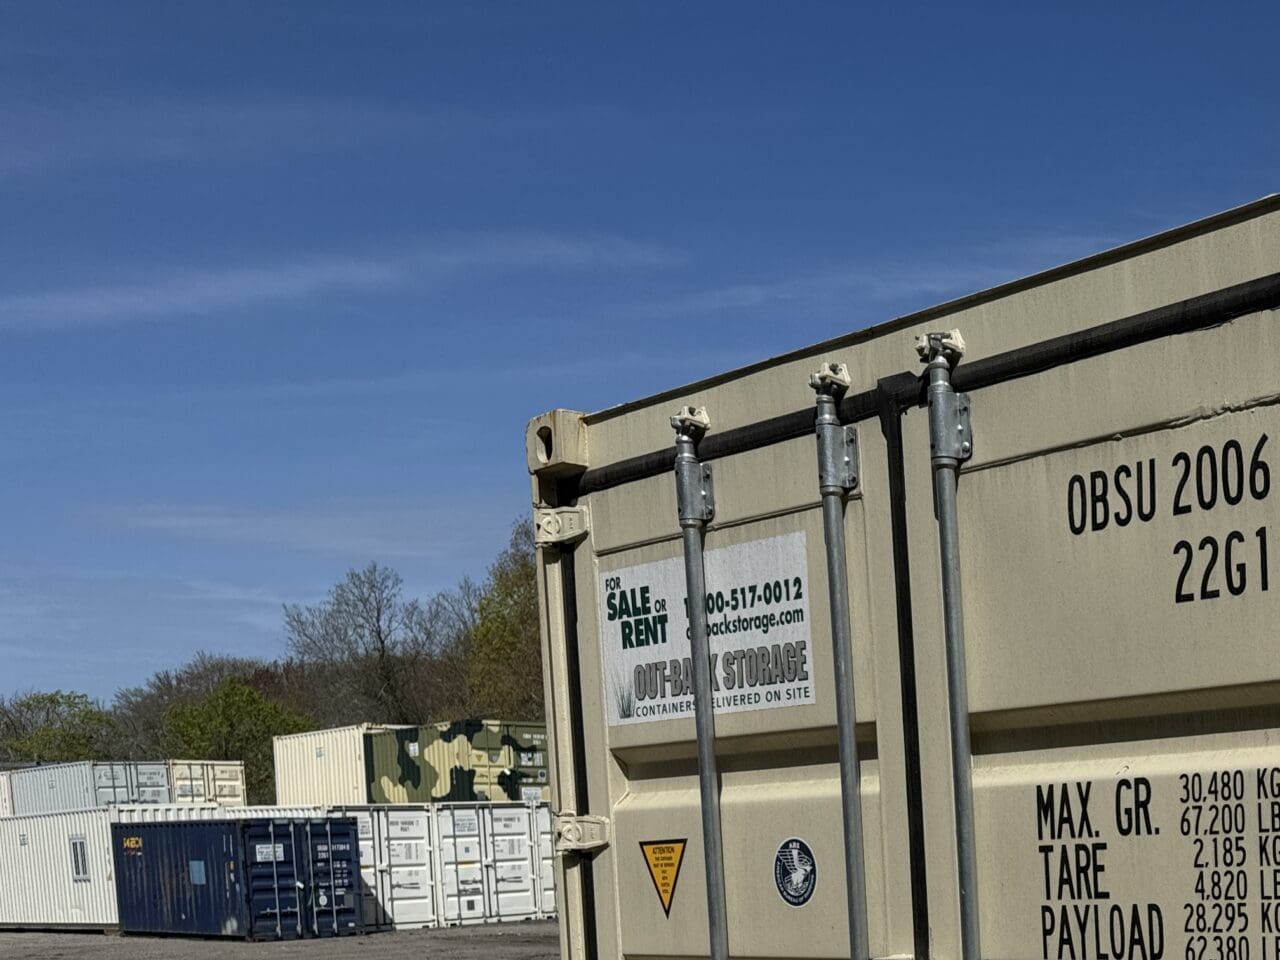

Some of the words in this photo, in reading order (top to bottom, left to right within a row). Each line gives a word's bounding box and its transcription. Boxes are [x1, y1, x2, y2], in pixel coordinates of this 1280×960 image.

[1067, 458, 1156, 535] OBSU
[605, 576, 622, 592] FOR
[1173, 526, 1268, 603] 22G1
[606, 585, 651, 621] SALE
[654, 599, 667, 613] OR
[620, 612, 668, 650] RENT
[722, 640, 809, 689] STORAGE
[765, 690, 781, 702] ON
[786, 686, 810, 700] SITE
[1036, 781, 1100, 840] MAX.
[1115, 777, 1160, 836] GR.
[1179, 769, 1245, 803] 30,480
[1180, 803, 1245, 836] 67,200
[1039, 842, 1110, 900] TARE
[1193, 836, 1246, 868] 2,185
[1194, 870, 1248, 901] 4,820
[1041, 903, 1164, 960] PAYLOAD
[1183, 902, 1249, 934] 28,295
